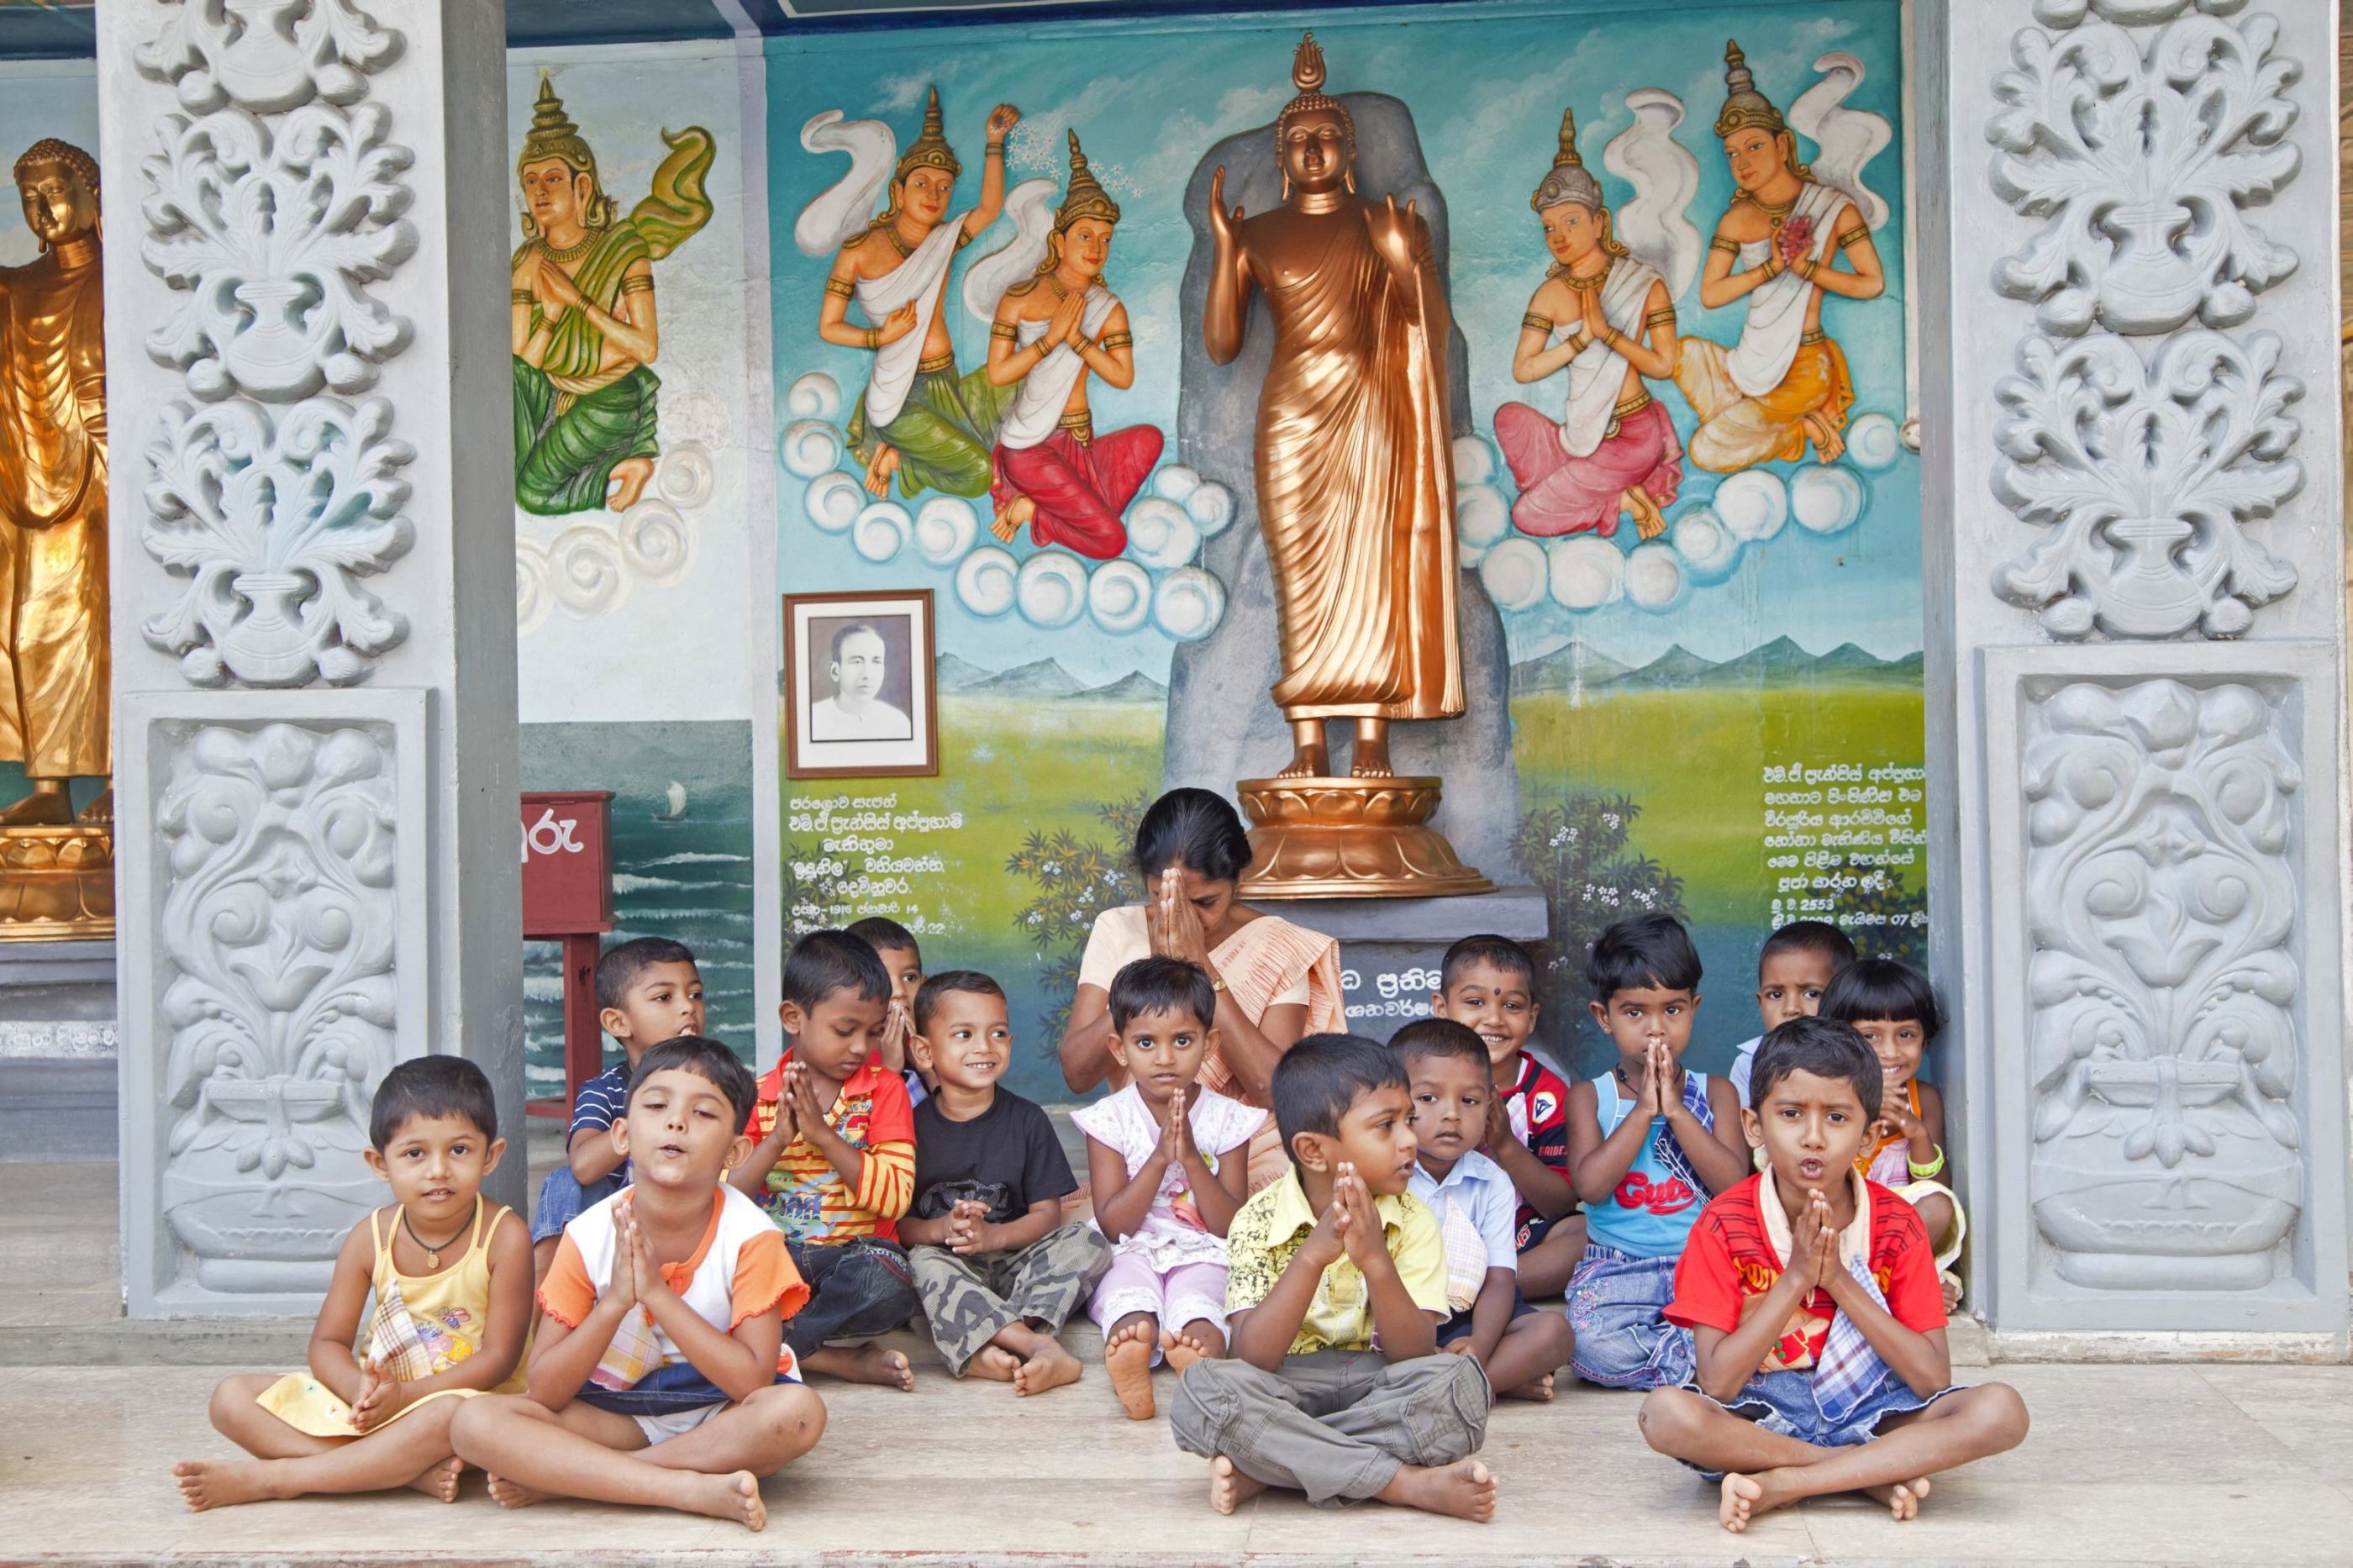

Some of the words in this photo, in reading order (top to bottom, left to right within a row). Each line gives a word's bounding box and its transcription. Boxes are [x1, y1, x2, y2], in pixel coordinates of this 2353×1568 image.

[1868, 762, 1926, 784] අප්පුහා
[829, 903, 852, 915] 1916
[906, 904, 919, 914] 14
[1800, 898, 1834, 911] 2553
[1891, 913, 1908, 926] 07
[1377, 968, 1442, 998] ප්‍රතිම
[1345, 999, 1435, 1018] ශතවර්ෂ
